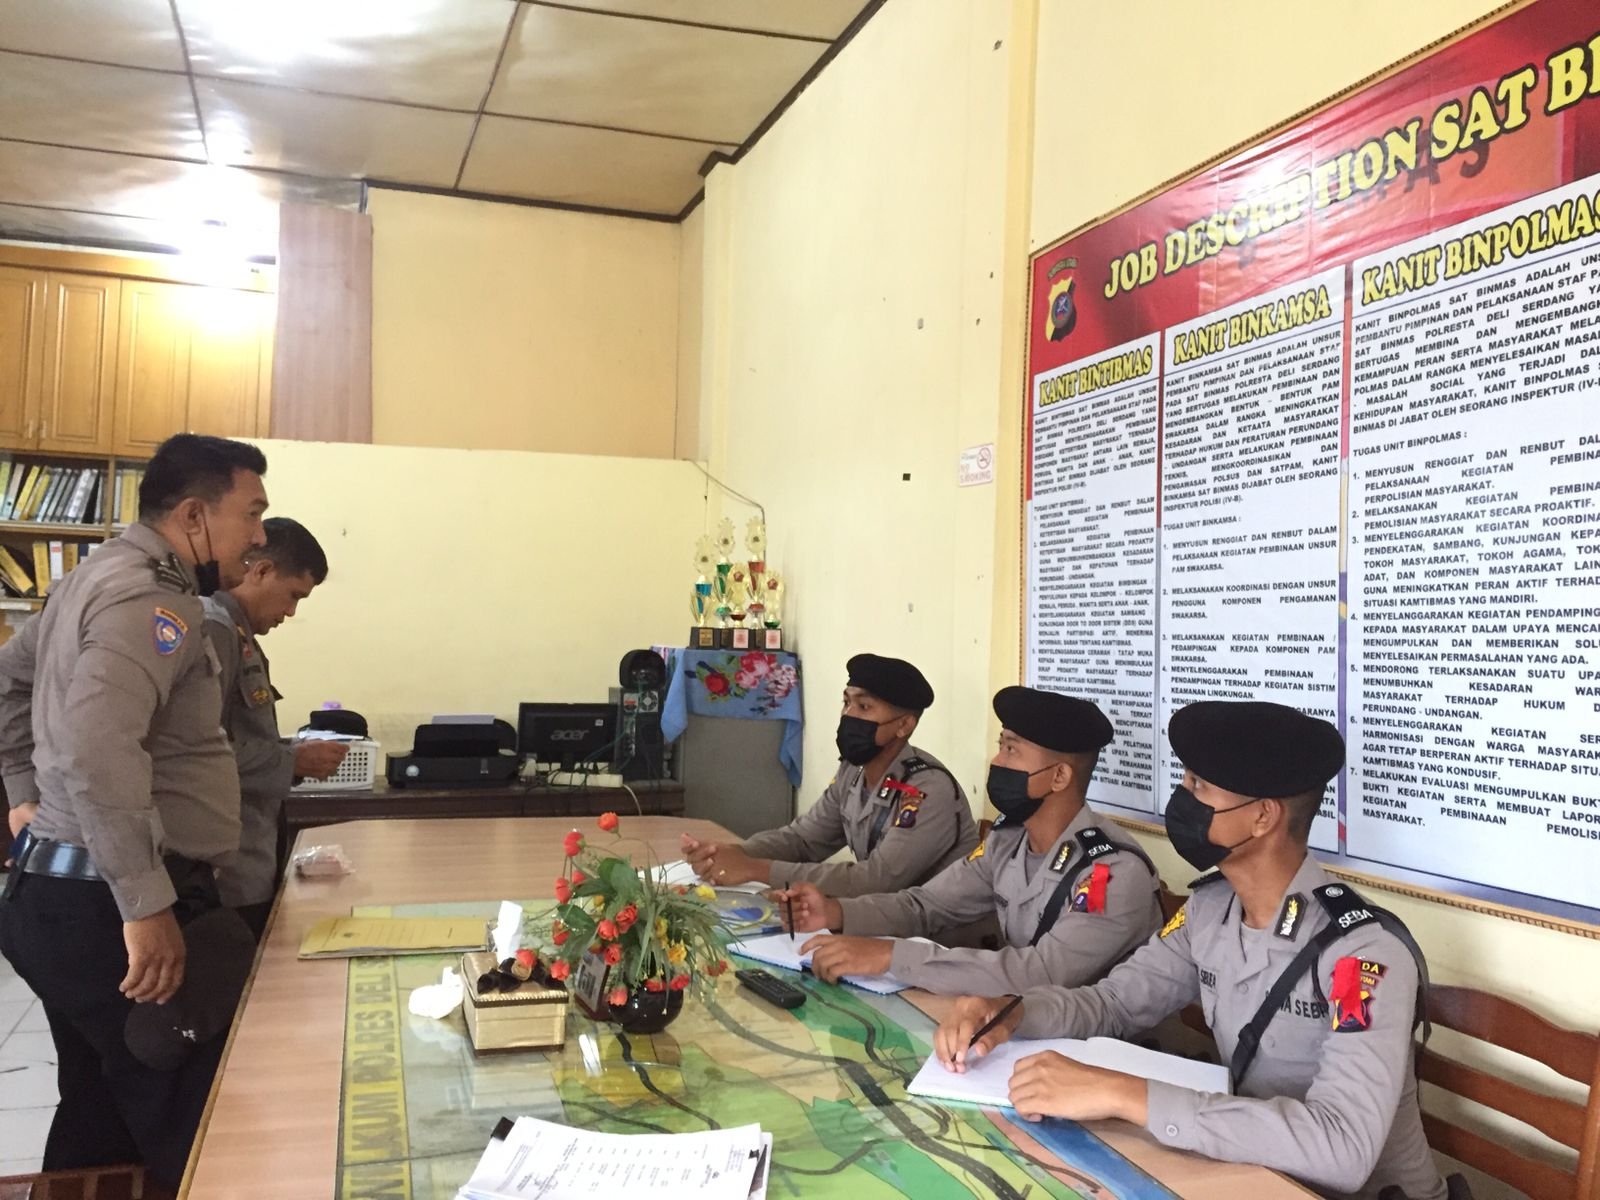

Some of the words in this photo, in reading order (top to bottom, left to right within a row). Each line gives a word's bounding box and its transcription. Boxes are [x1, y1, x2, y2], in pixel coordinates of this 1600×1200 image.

[1104, 241, 1158, 298] JOB
[1430, 64, 1538, 161] SAT
[1362, 245, 1441, 305] KANIT
[1354, 317, 1381, 333] KANIT
[1388, 300, 1441, 323] BINPOLMAS
[1448, 291, 1468, 305] SAT
[1476, 277, 1516, 297] BINMAS
[1524, 261, 1570, 283] ADALAH
[1173, 319, 1227, 365] KANIT
[1229, 284, 1331, 347] BINKAMSA
[1354, 362, 1409, 384] KEMAMPUAN
[1414, 353, 1446, 369] PERAN
[1450, 344, 1483, 360] SERTA
[1488, 323, 1563, 351] MASYARAKAT
[1039, 370, 1077, 407] KANIT
[1078, 345, 1152, 394] BINTIBMAS
[1271, 372, 1318, 392] PEMBINAAN
[1322, 366, 1340, 379] DAN
[1283, 404, 1339, 424] MASYARAKAT
[1353, 420, 1386, 434] BINMAS
[1387, 417, 1397, 427] DI
[1399, 411, 1429, 425] JABAT
[1430, 406, 1457, 419] OLEH
[1458, 395, 1508, 414] SEORANG
[1510, 382, 1575, 403] INSPEKTUR
[1288, 417, 1339, 435] PERUNDANG
[1320, 442, 1338, 453] DAN
[1352, 444, 1382, 457] TUGAS
[1382, 440, 1405, 452] UNIT
[1406, 430, 1462, 448] BINPOLMAS
[1364, 463, 1414, 478] MENYUSUN
[1424, 453, 1474, 469] RENGGIAT
[1485, 448, 1508, 460] DAN
[1519, 439, 1565, 455] RENBUT
[1364, 489, 1423, 504] PERPOLISIAN
[1364, 516, 1418, 530] PEMOLISIAN
[1419, 509, 1486, 524] MASYARAKAT
[1489, 504, 1532, 518] SECARA
[1250, 532, 1267, 542] DAN
[1270, 528, 1303, 539] RENBUT
[1307, 524, 1337, 536] DALAM
[1492, 531, 1561, 546] KUNJUNGAN
[1363, 558, 1394, 569] TOKOH
[1476, 550, 1514, 561] TOKOH
[1396, 570, 1416, 580] DAN
[1424, 567, 1480, 579] KOMPONEN
[1488, 561, 1563, 575] MASYARAKAT
[1362, 585, 1388, 595] GUNA
[1474, 580, 1509, 590] PERAN
[1515, 578, 1548, 589] AKTIF
[1279, 593, 1336, 604] PENGAMANAN
[1363, 598, 1398, 608] SITUASI
[1399, 596, 1456, 606] KAMTIBMAS
[1458, 595, 1487, 605] YANG
[1467, 609, 1521, 619] KEGIATAN
[1265, 645, 1310, 654] KOMPONEN
[1317, 646, 1336, 654] PAM
[1440, 652, 1524, 663] PERMASALAHAN
[1526, 654, 1558, 664] YANG
[1362, 664, 1419, 674] MENDORONG
[1428, 666, 1516, 678] TERLAKSANAKAN
[1527, 668, 1566, 679] SUATU
[1264, 680, 1304, 691] KEGIATAN
[1307, 682, 1335, 692] SISTIM
[1362, 677, 1433, 689] MENUMBUHKAN
[1468, 681, 1533, 693] KESADARAN
[1362, 703, 1416, 716] PERUNDANG
[551, 730, 589, 740] acer
[1362, 729, 1424, 743] HARMONISASI
[1434, 735, 1475, 748] DENGAN
[1486, 740, 1525, 753] WARGA
[1362, 742, 1386, 753] AGAR
[1388, 744, 1417, 756] TETAP
[1419, 748, 1471, 762] BERPERAN
[1473, 754, 1504, 766] AKTIF
[1507, 757, 1567, 772] TERHADAP
[1362, 755, 1415, 770] KAMTIBMAS
[1416, 761, 1444, 774] YANG
[1362, 781, 1389, 794] BUKTI
[1396, 786, 1445, 802] KEGIATAN
[1454, 794, 1487, 808] SERTA
[1496, 800, 1551, 817] MEMBUAT
[1088, 844, 1113, 856] SEBA
[1338, 909, 1374, 928] SEBA
